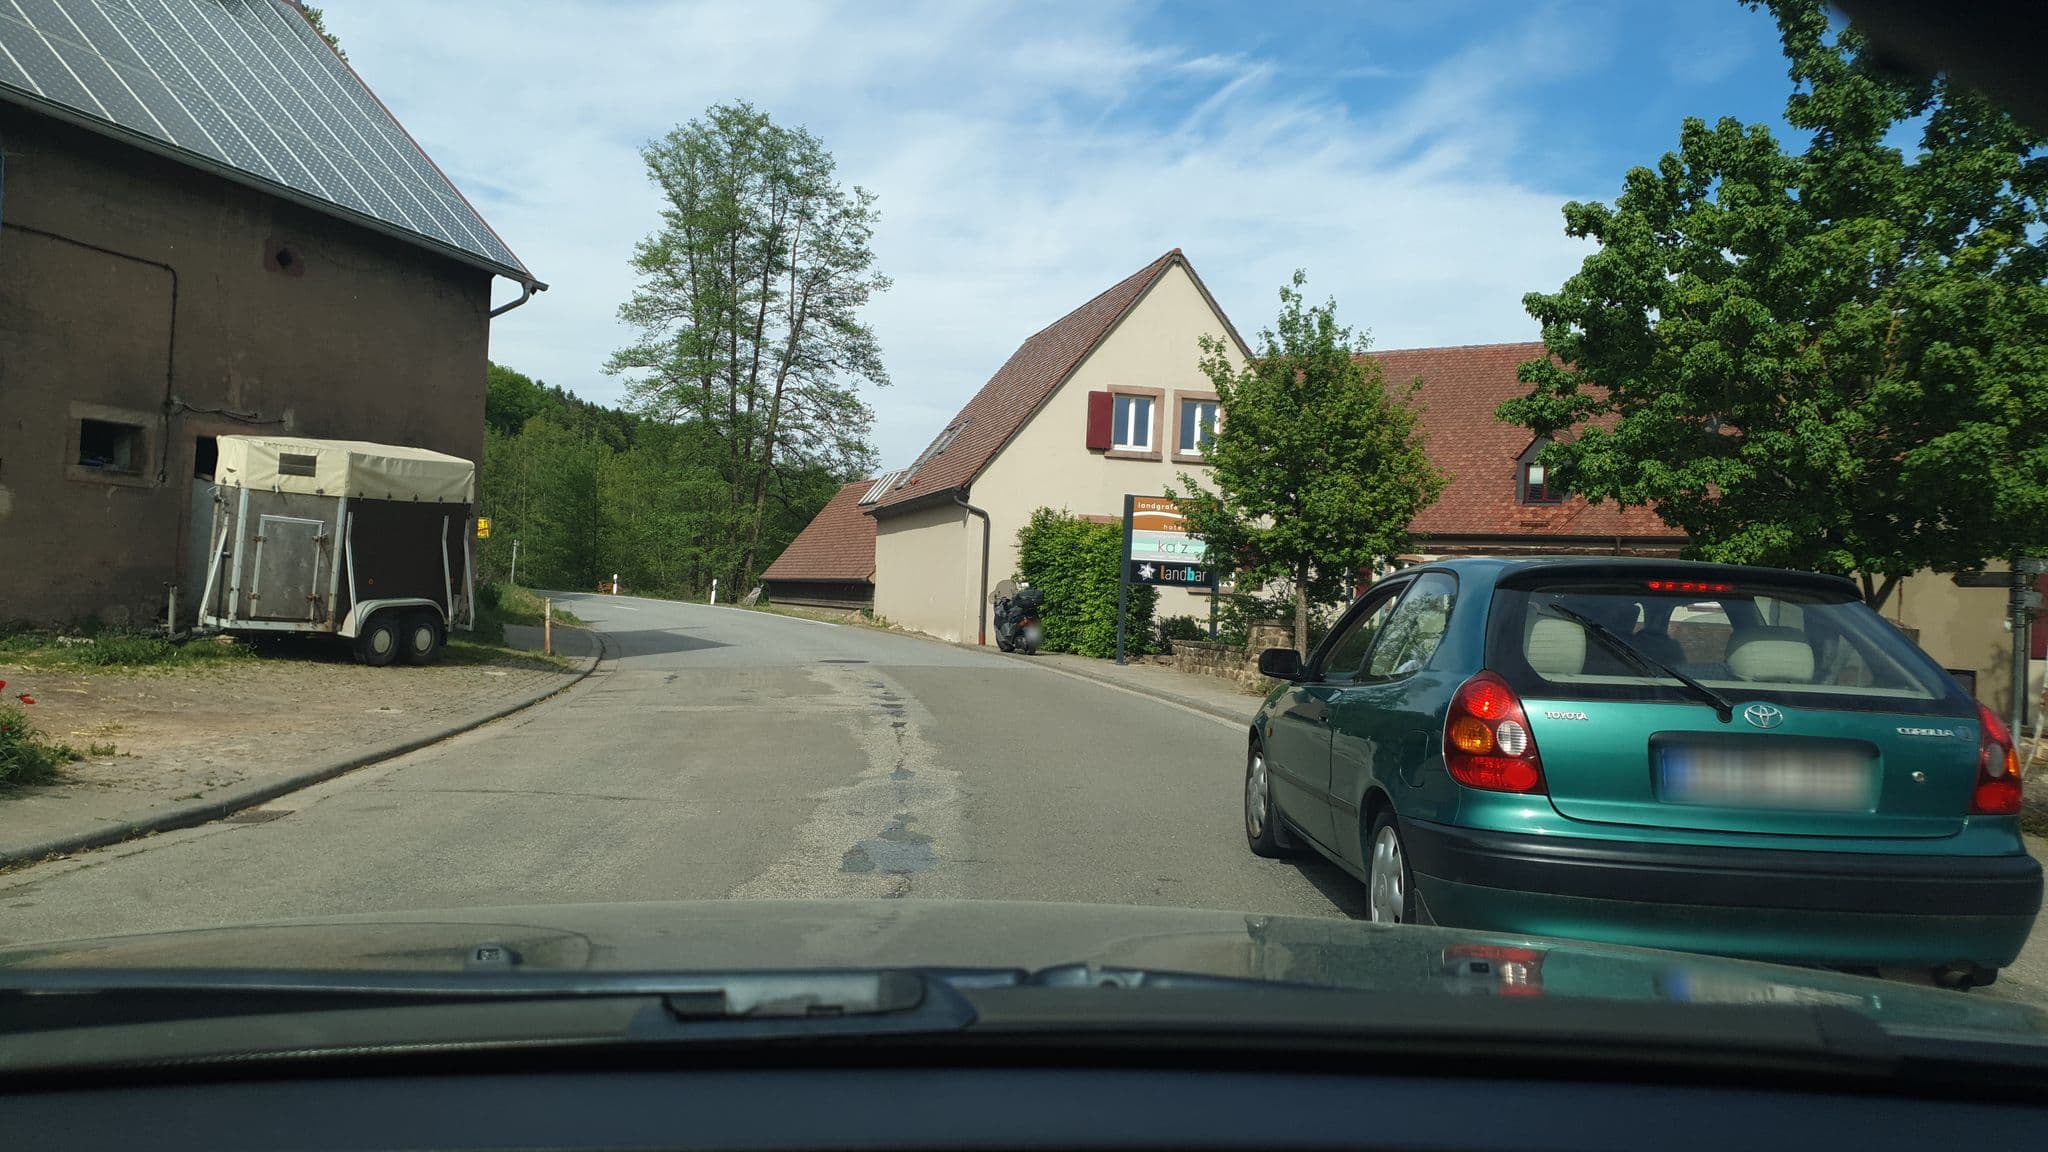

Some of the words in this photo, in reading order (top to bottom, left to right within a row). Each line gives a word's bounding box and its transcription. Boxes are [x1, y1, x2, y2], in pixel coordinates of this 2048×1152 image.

[1138, 502, 1178, 511] landgrafe
[1160, 565, 1207, 582] landbar
[1545, 711, 1588, 720] TOYOTA
